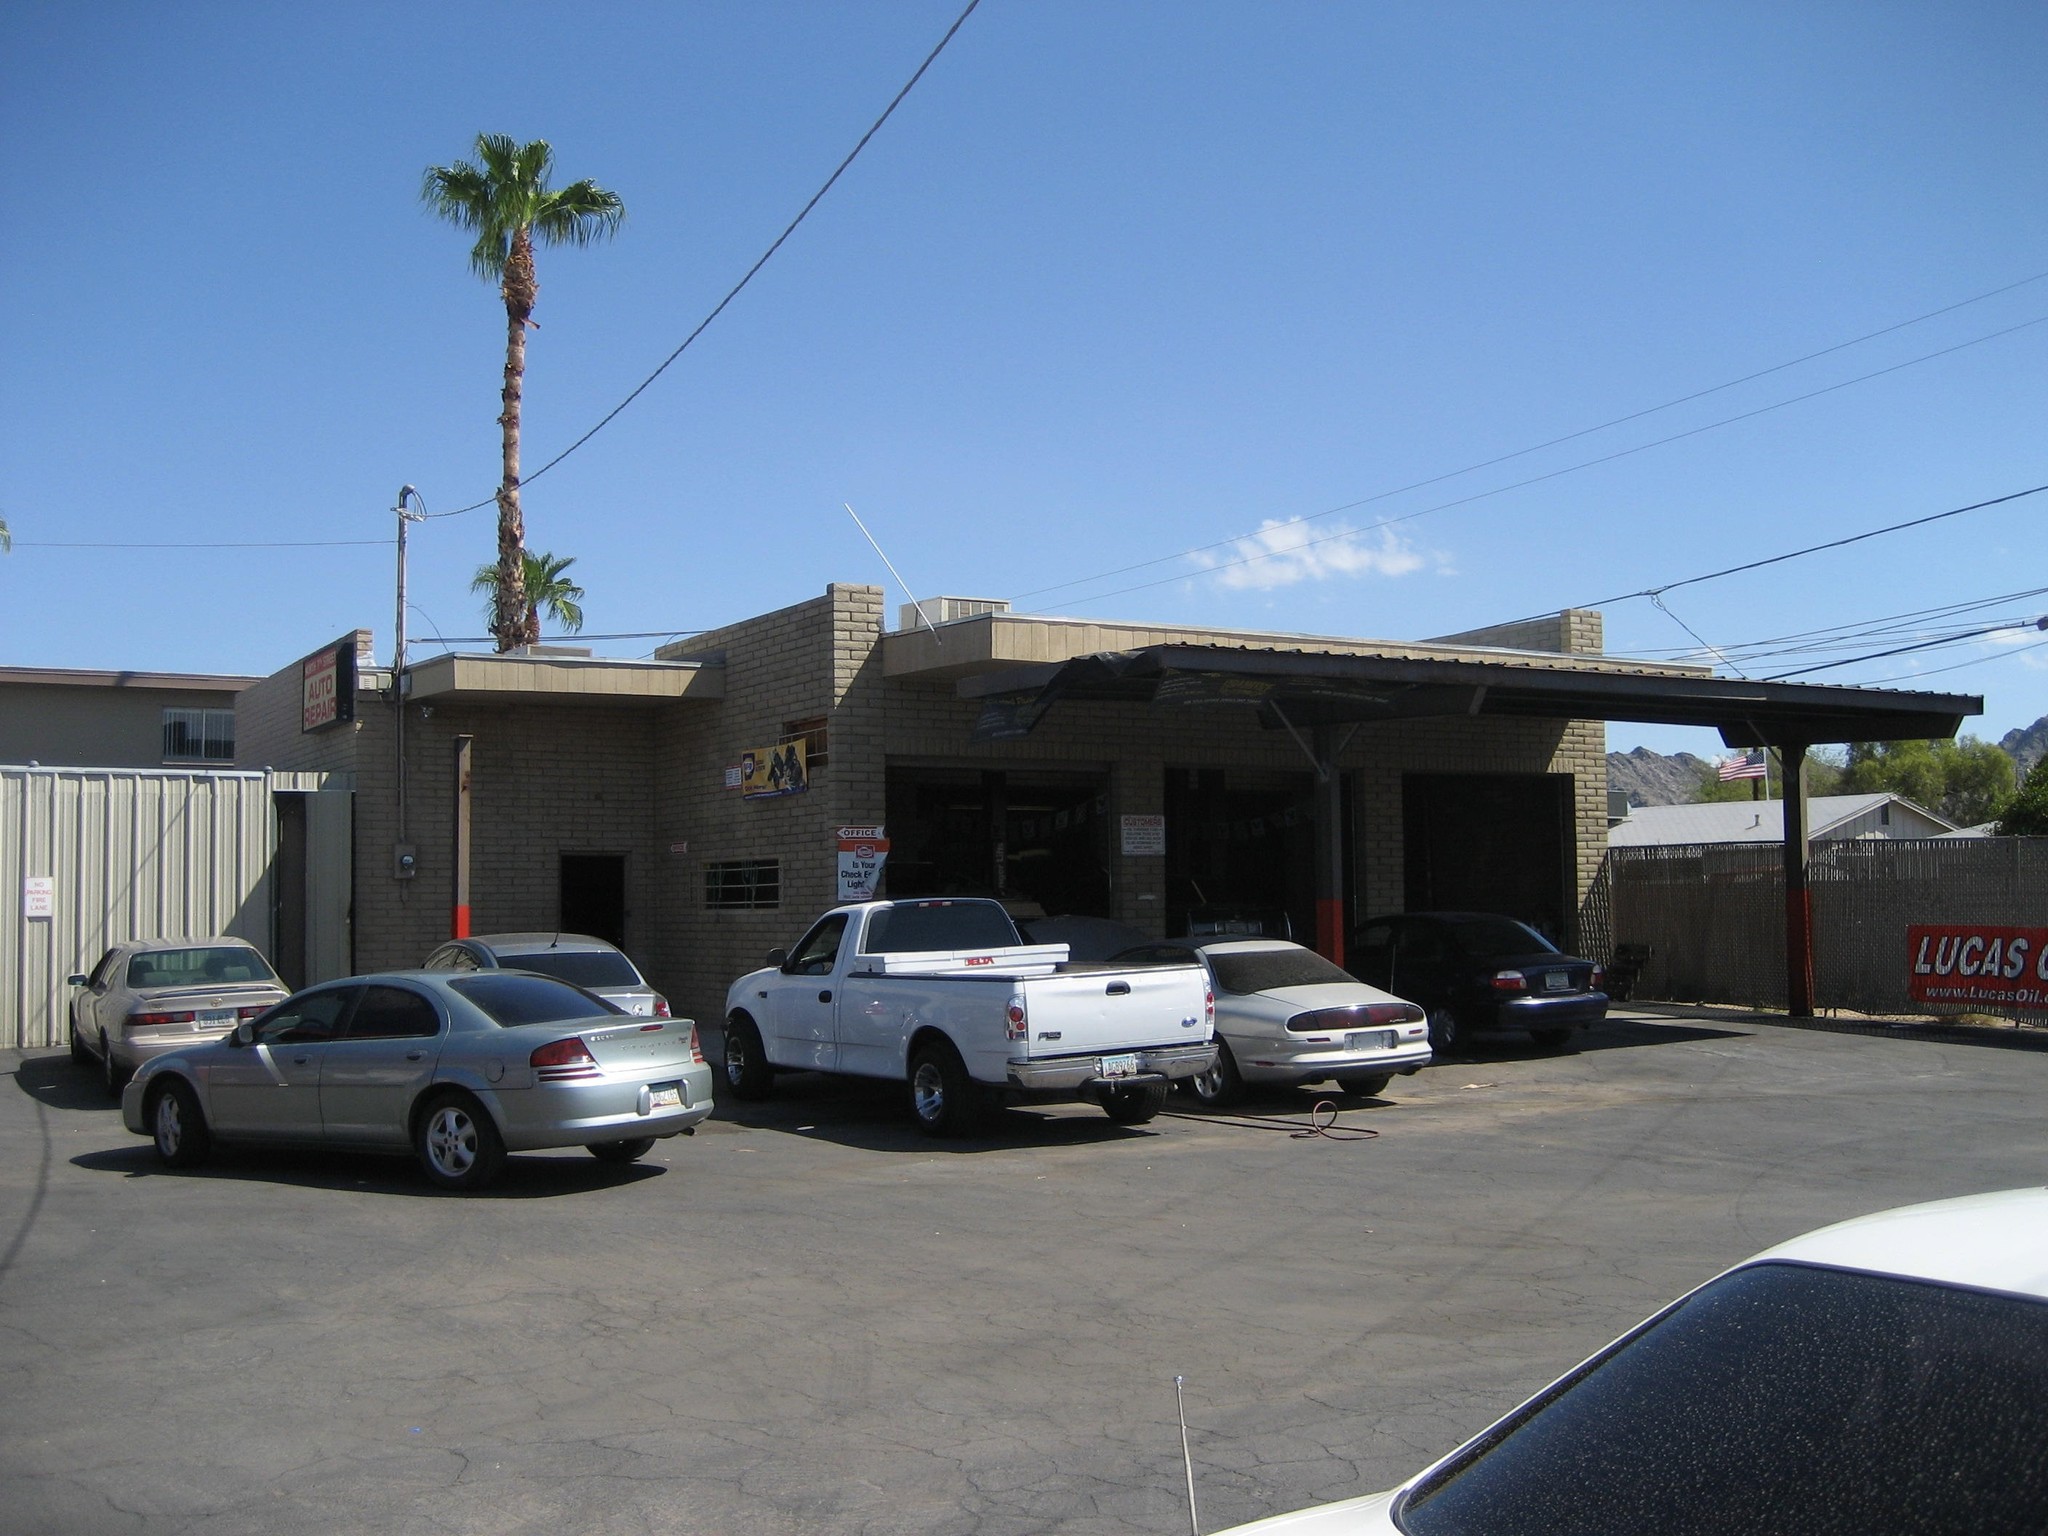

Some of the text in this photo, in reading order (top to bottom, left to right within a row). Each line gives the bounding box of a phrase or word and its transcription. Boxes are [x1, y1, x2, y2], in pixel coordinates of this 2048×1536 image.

[309, 674, 333, 702] AUTO
[304, 696, 337, 728] REPAIR
[843, 829, 877, 837] OFFICE
[1914, 936, 2029, 979] LUCAS
